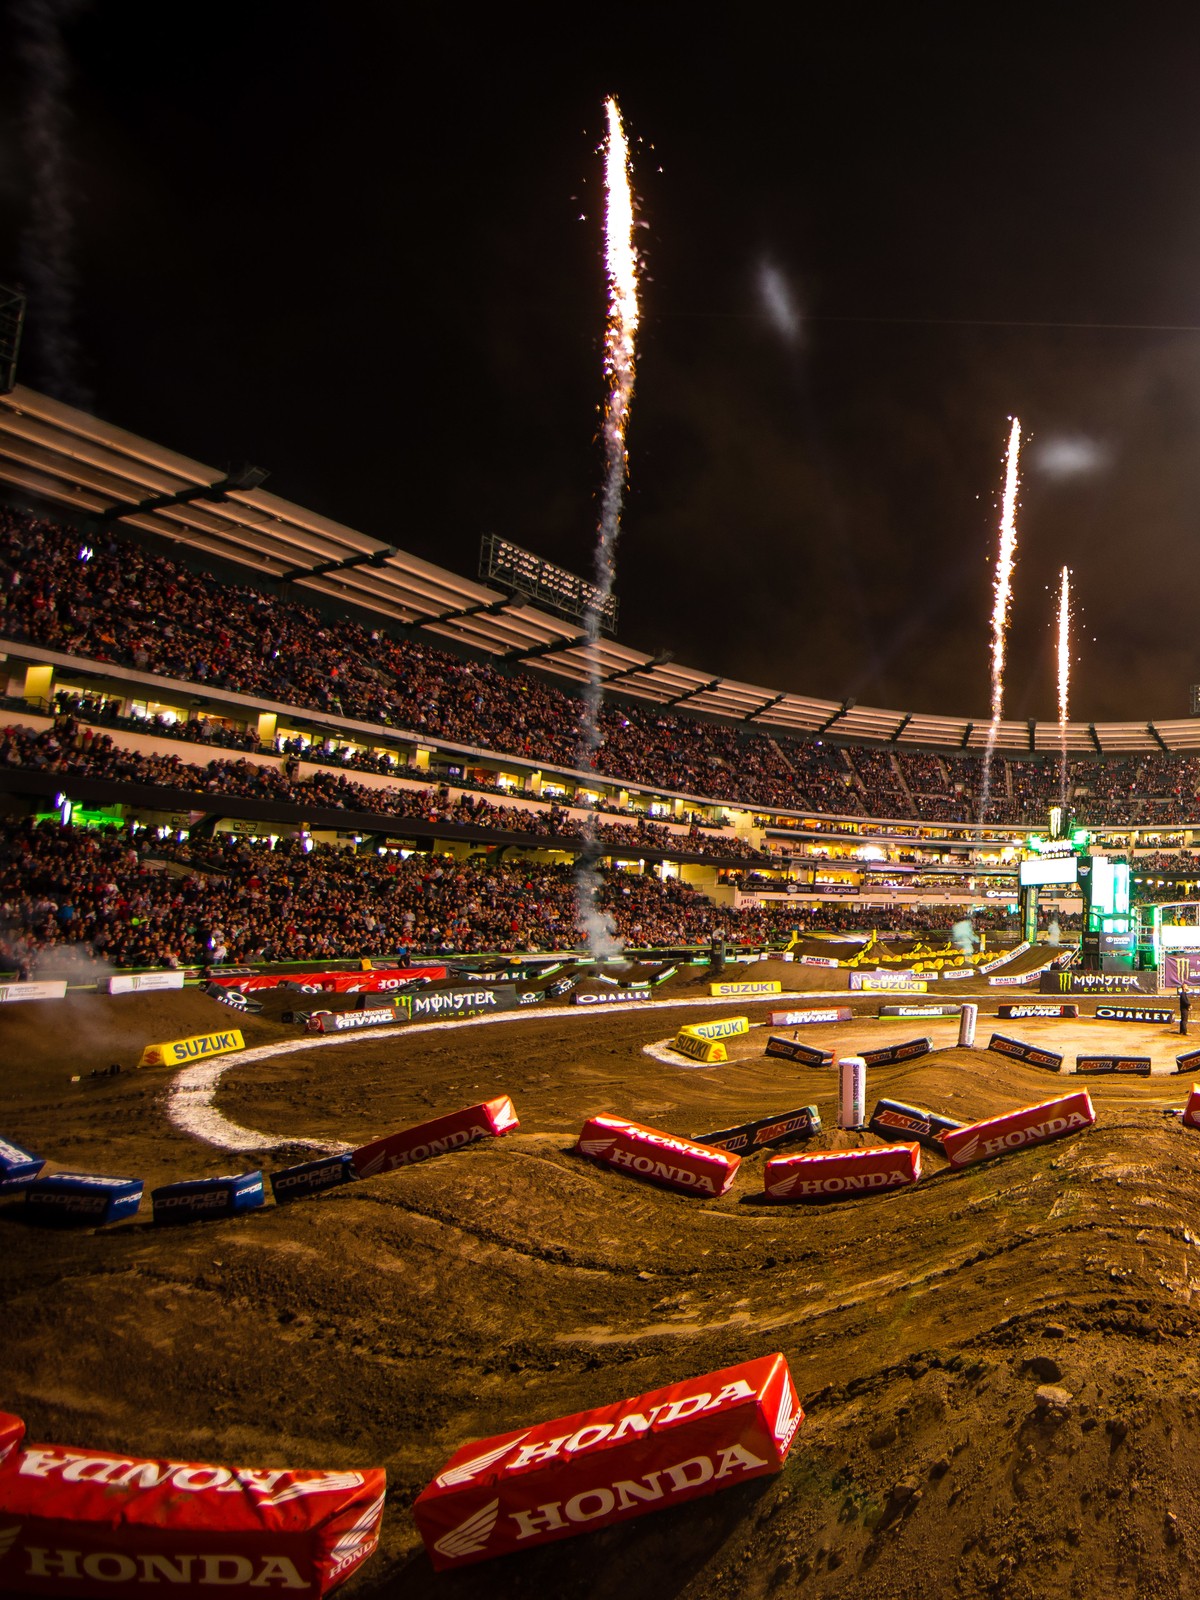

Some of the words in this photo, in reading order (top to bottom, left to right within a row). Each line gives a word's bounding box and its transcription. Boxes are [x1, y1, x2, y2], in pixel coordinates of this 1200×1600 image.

[720, 983, 775, 994] SUZUKI
[871, 981, 921, 990] SUZUKI
[1074, 973, 1140, 987] MONSTER
[217, 995, 249, 1012] OAKLEY
[415, 990, 497, 1013] MONSTER
[600, 991, 650, 1001] OAKLEY
[363, 1008, 392, 1017] MOUNTAIN
[899, 1007, 943, 1016] Kawasaki
[1115, 1012, 1171, 1022] OAKLEY
[697, 1021, 744, 1040] SUZUKI
[172, 1032, 238, 1060] SUZUKI
[675, 1036, 709, 1059] SUZUKI
[990, 1040, 1025, 1055] AMSOIL
[1025, 1052, 1061, 1067] AMSOIL
[1079, 1061, 1113, 1071] AMSOIL
[1115, 1061, 1151, 1071] AMSOIL
[753, 1114, 809, 1145] AMSOIL
[875, 1110, 931, 1135] AMSOIL
[983, 1111, 1090, 1155] HONDA
[389, 1125, 492, 1169] HONDA
[275, 1163, 343, 1189] COOPER
[310, 1173, 342, 1187] TIRES
[610, 1148, 717, 1193] HONDA
[800, 1170, 911, 1195] HONDA
[155, 1190, 229, 1209] COOPER
[506, 1379, 757, 1469] HONDA
[18, 1449, 294, 1493] HONDA
[509, 1443, 768, 1540] HONDA
[24, 1546, 311, 1589] HONDA
